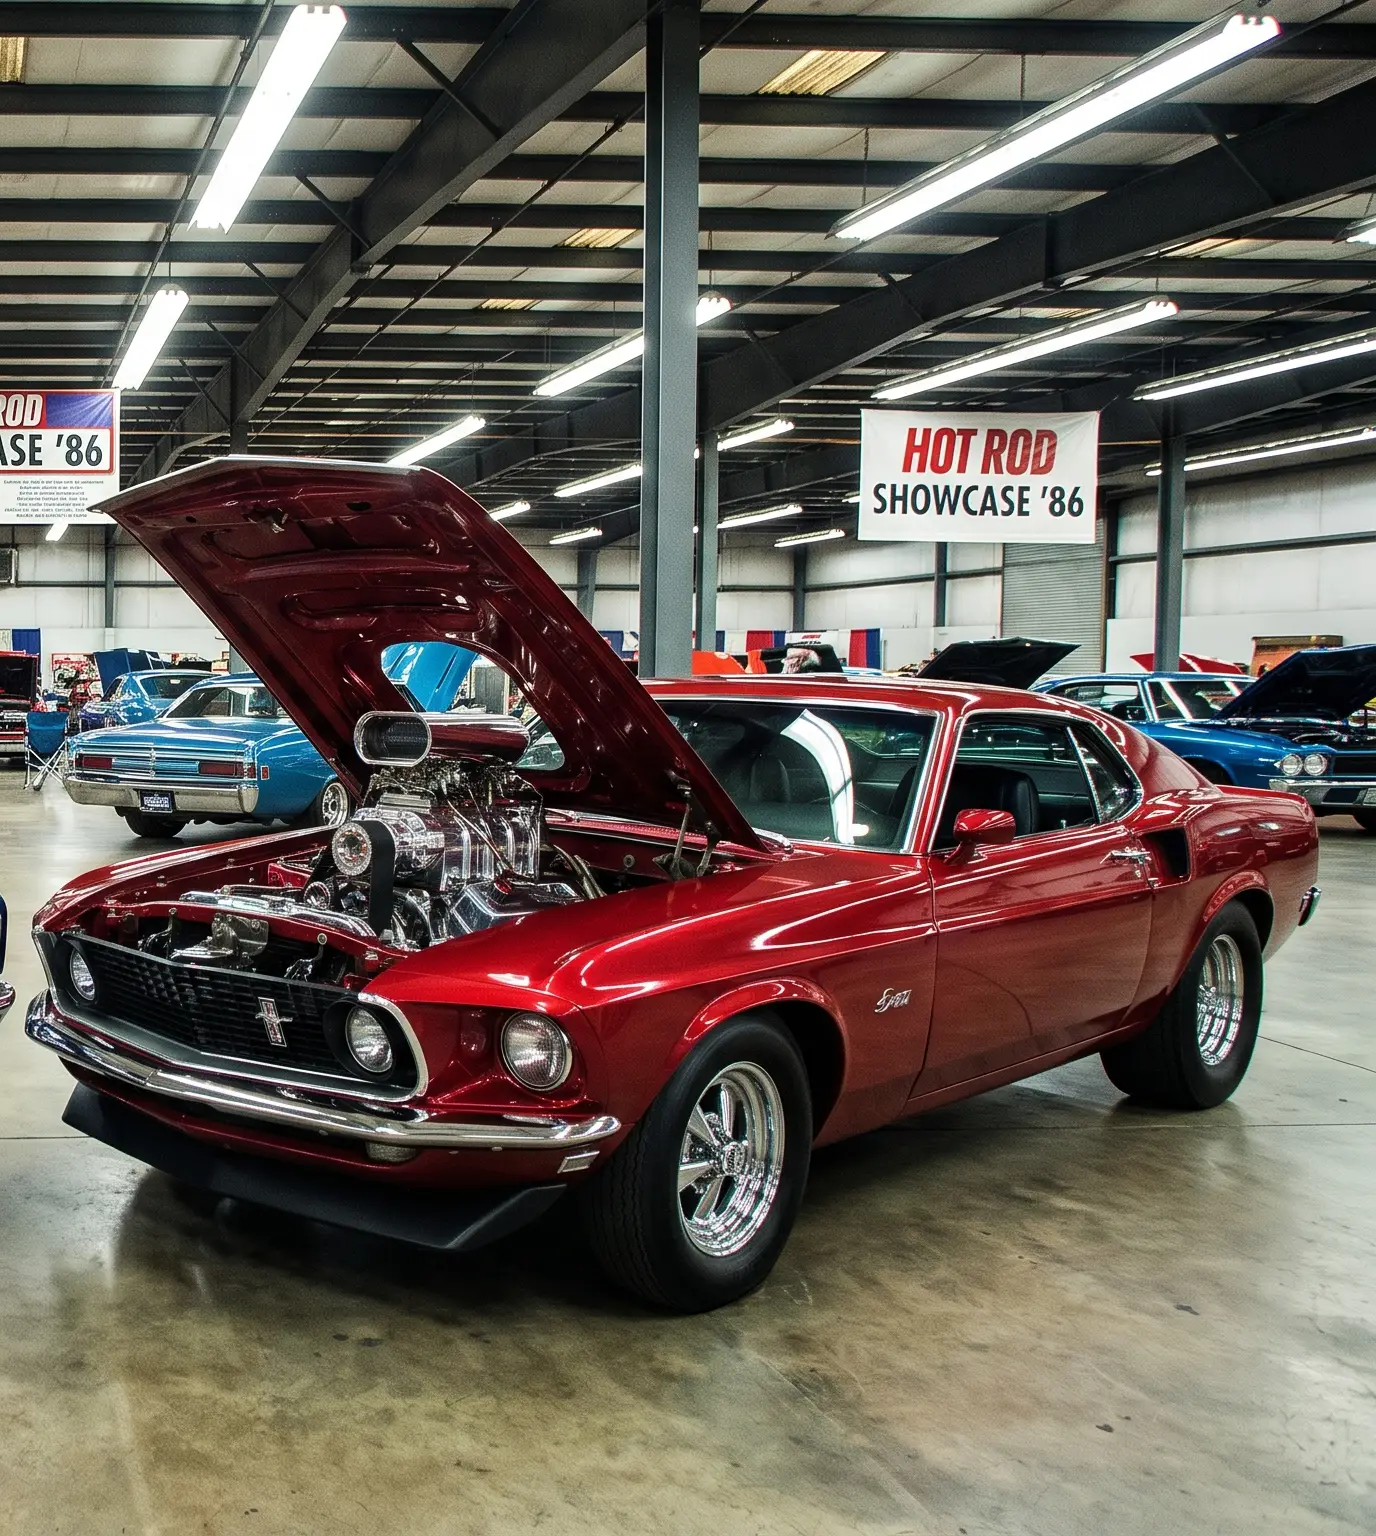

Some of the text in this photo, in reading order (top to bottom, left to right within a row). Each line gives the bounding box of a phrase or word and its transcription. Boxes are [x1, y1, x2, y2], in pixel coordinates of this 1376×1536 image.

[55, 434, 103, 467] '86
[901, 427, 1058, 475] HOT ROD
[873, 483, 1084, 517] SHOWCASE '86
